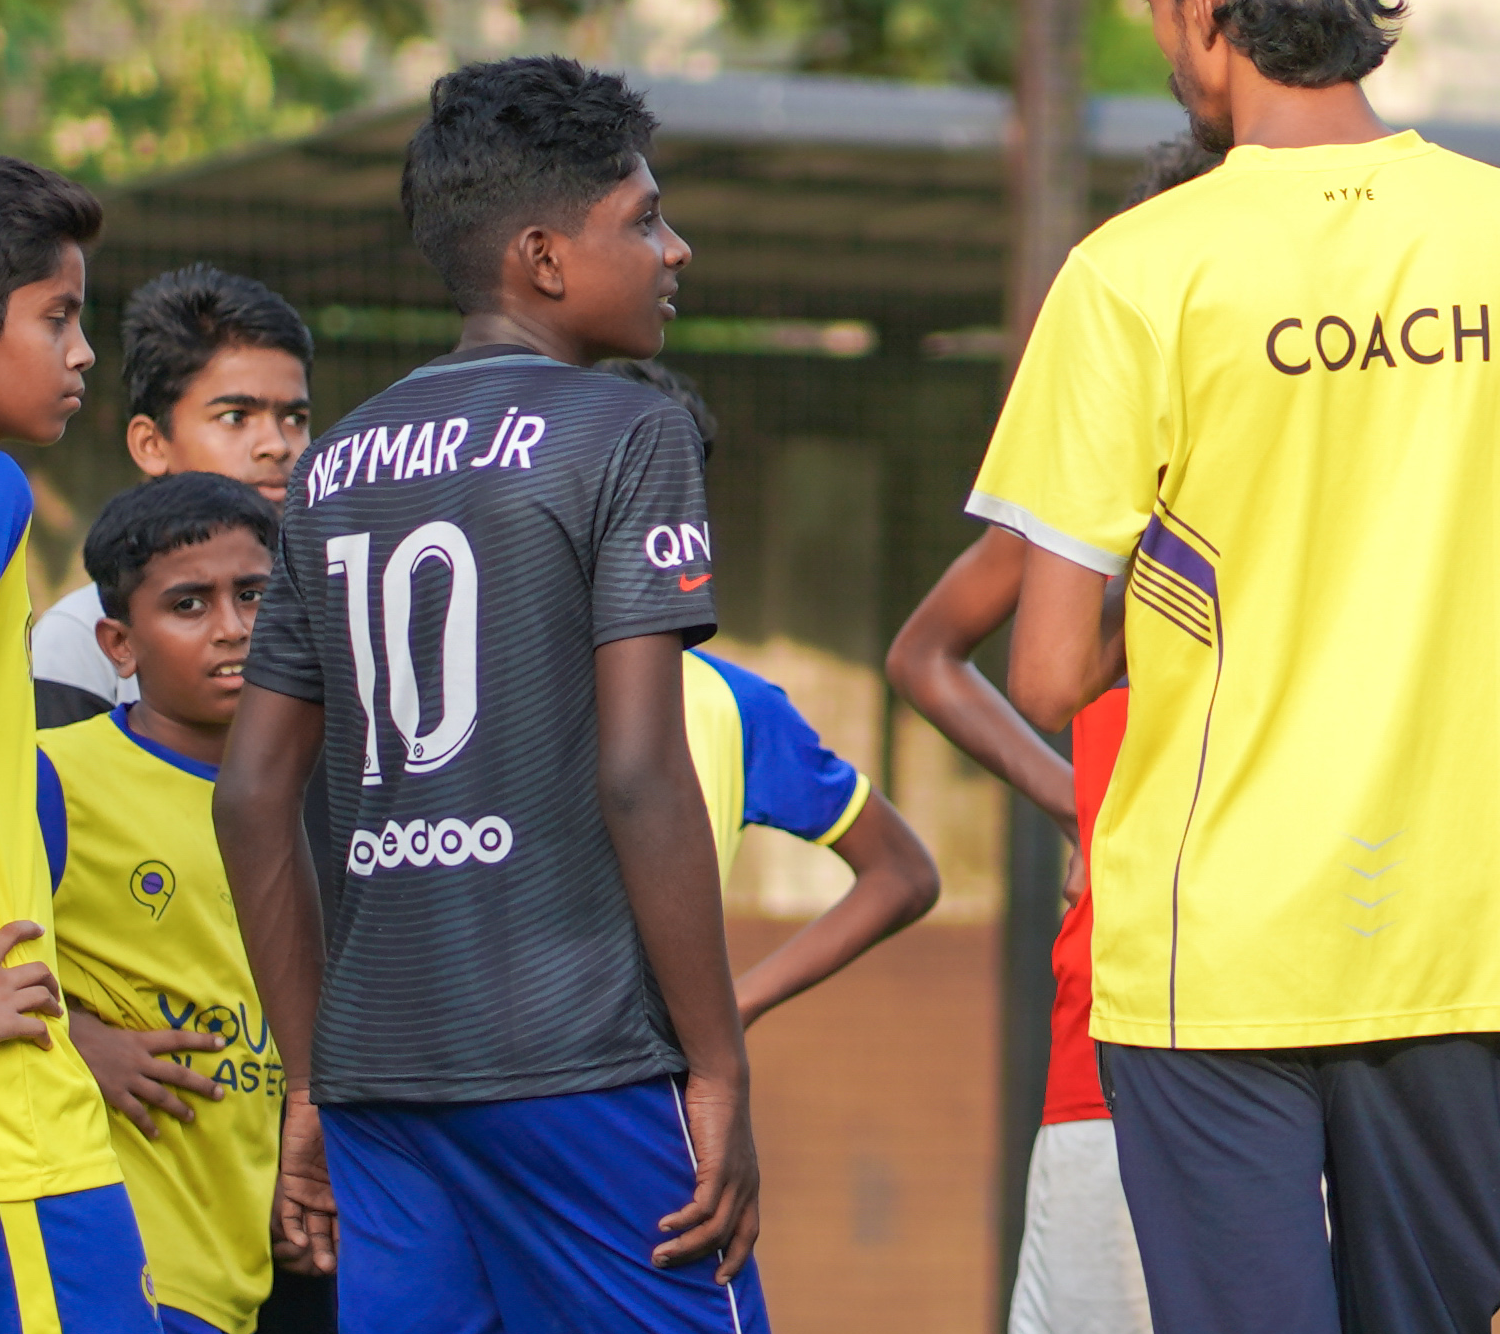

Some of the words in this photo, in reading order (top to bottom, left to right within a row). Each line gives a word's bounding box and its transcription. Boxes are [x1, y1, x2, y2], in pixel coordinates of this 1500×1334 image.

[1266, 304, 1490, 375] COACH
[307, 417, 469, 508] NEYMAR
[326, 520, 478, 786] 10
